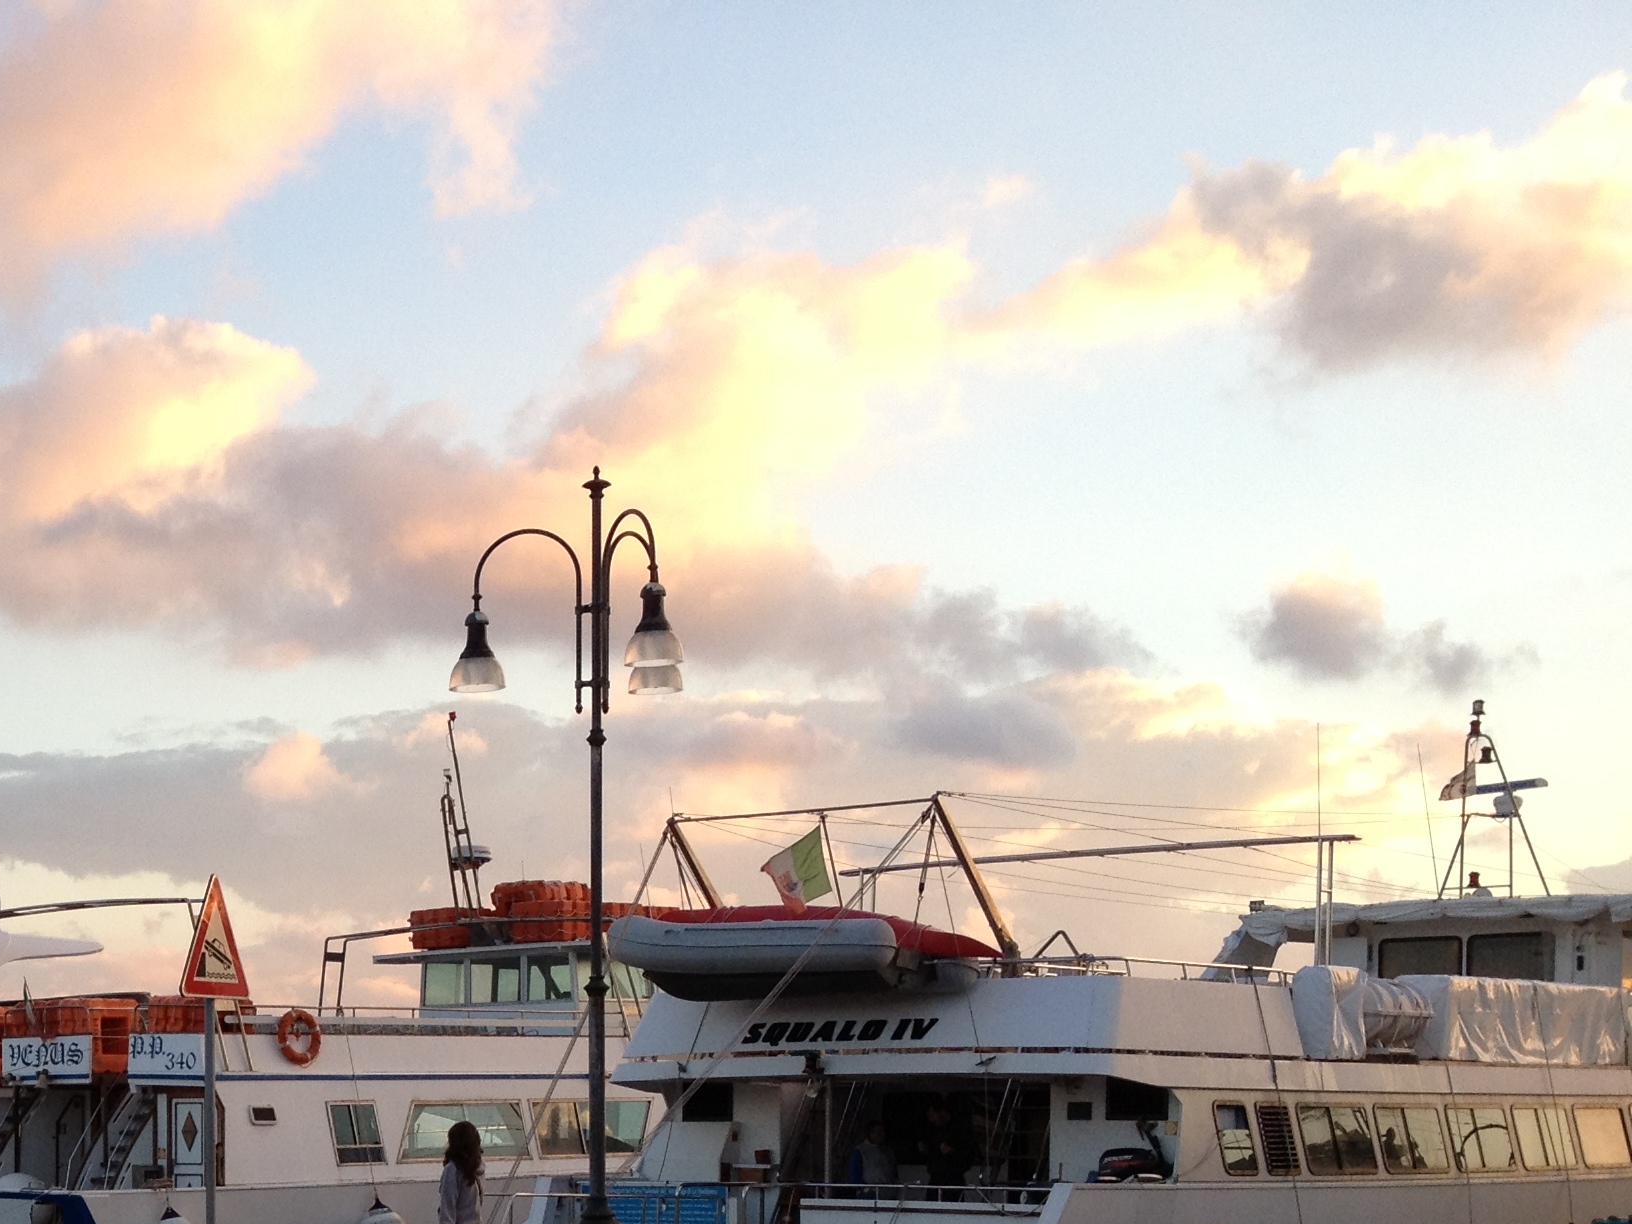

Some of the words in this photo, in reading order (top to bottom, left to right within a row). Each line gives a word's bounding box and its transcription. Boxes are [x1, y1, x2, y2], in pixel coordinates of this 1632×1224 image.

[741, 1019, 888, 1047] SQUALO
[890, 1018, 940, 1041] IV
[8, 1041, 84, 1068] VENUS
[164, 1051, 197, 1070] 340
